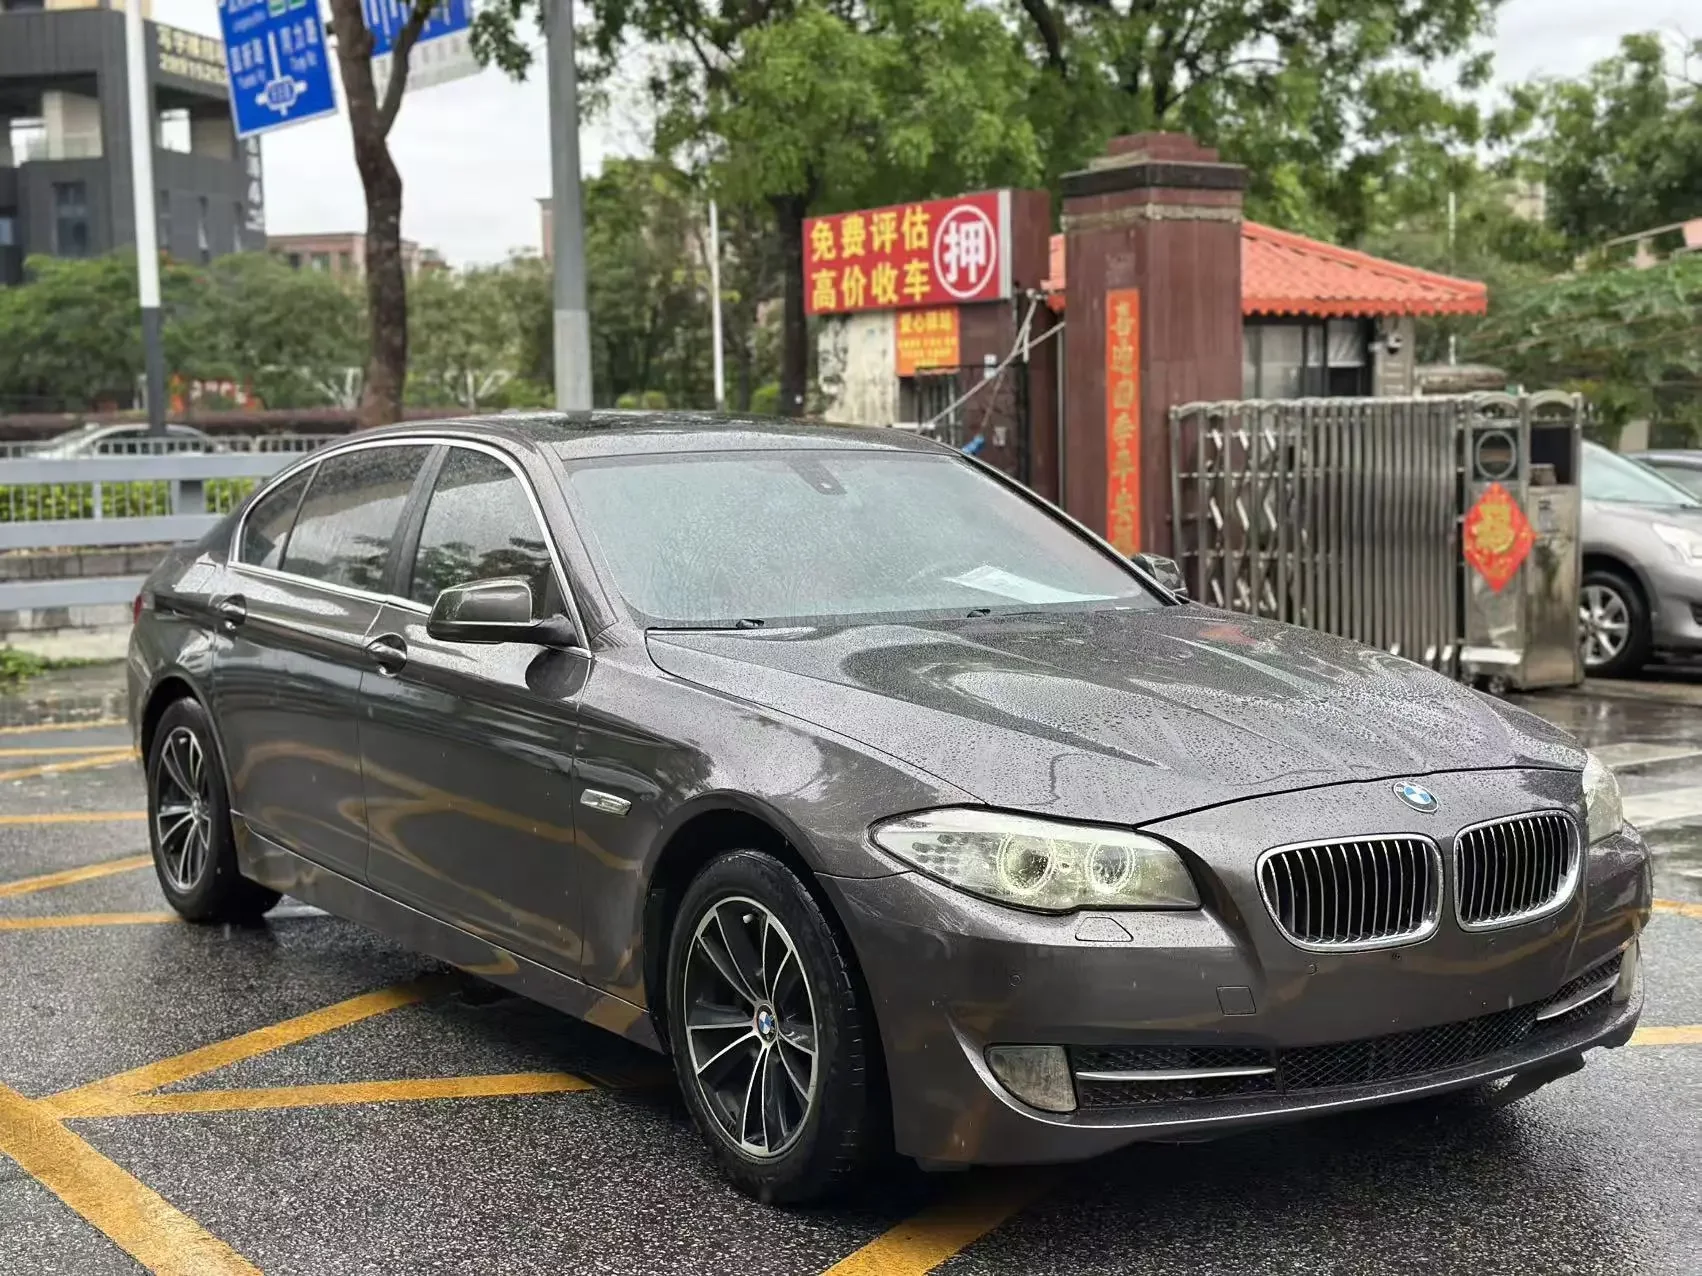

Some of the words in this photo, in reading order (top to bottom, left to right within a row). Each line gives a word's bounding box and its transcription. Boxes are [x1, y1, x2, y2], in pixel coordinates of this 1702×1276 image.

[809, 205, 932, 262] 免费评估
[943, 220, 987, 285] 押
[811, 259, 932, 311] 高价收车
